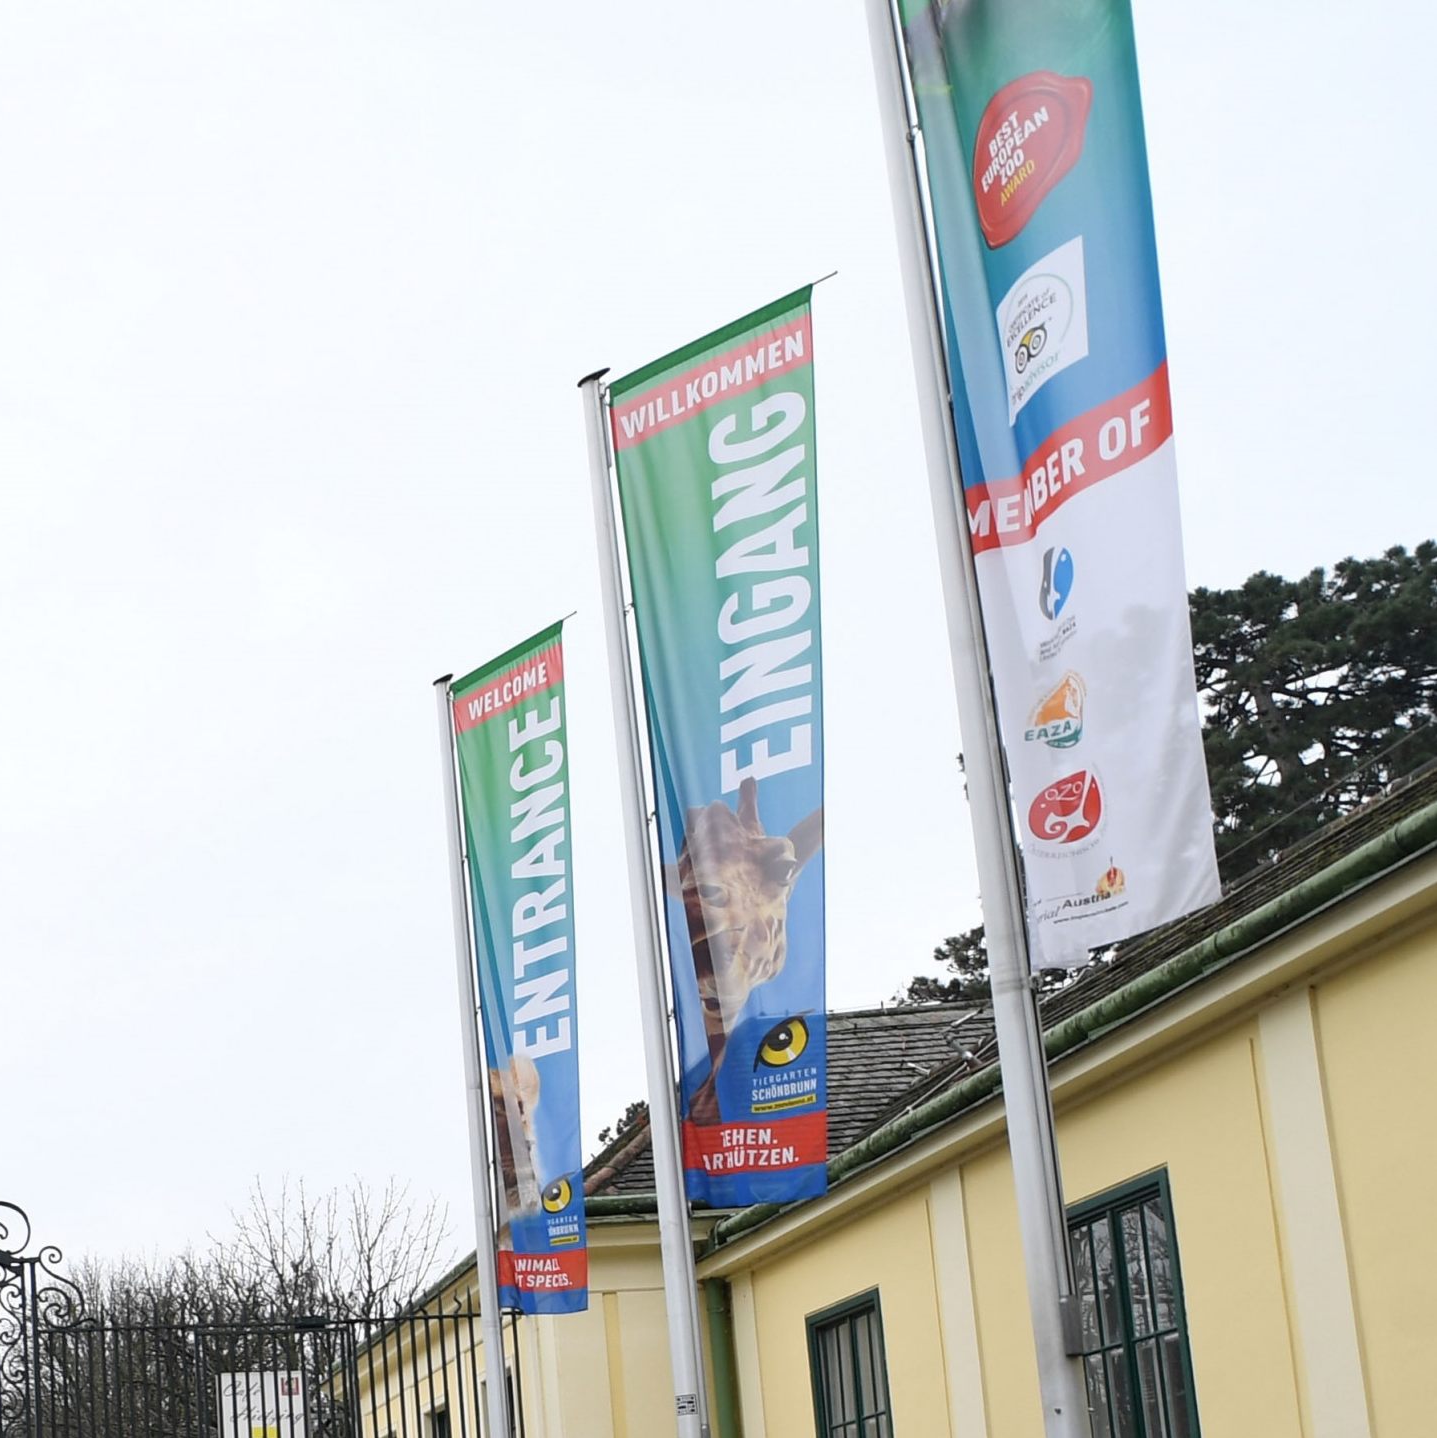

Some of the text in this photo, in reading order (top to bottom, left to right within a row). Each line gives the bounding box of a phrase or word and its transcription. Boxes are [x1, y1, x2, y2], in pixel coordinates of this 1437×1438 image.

[982, 106, 1049, 193] EUROPEAN
[989, 111, 1018, 158] BEST
[1000, 149, 1024, 186] ZOO
[1001, 160, 1035, 206] AWARD
[620, 330, 804, 438] WILLKOMMEN
[1098, 399, 1150, 461] OF
[709, 391, 812, 795] EINGANG
[468, 662, 547, 720] WELCOME
[1024, 720, 1071, 741] EAZA
[508, 696, 571, 1060] ENTRANCE
[1062, 891, 1111, 909] Austria
[751, 1078, 817, 1101] SCHÖNBRUNN
[753, 1067, 817, 1087] TIERGARTEN
